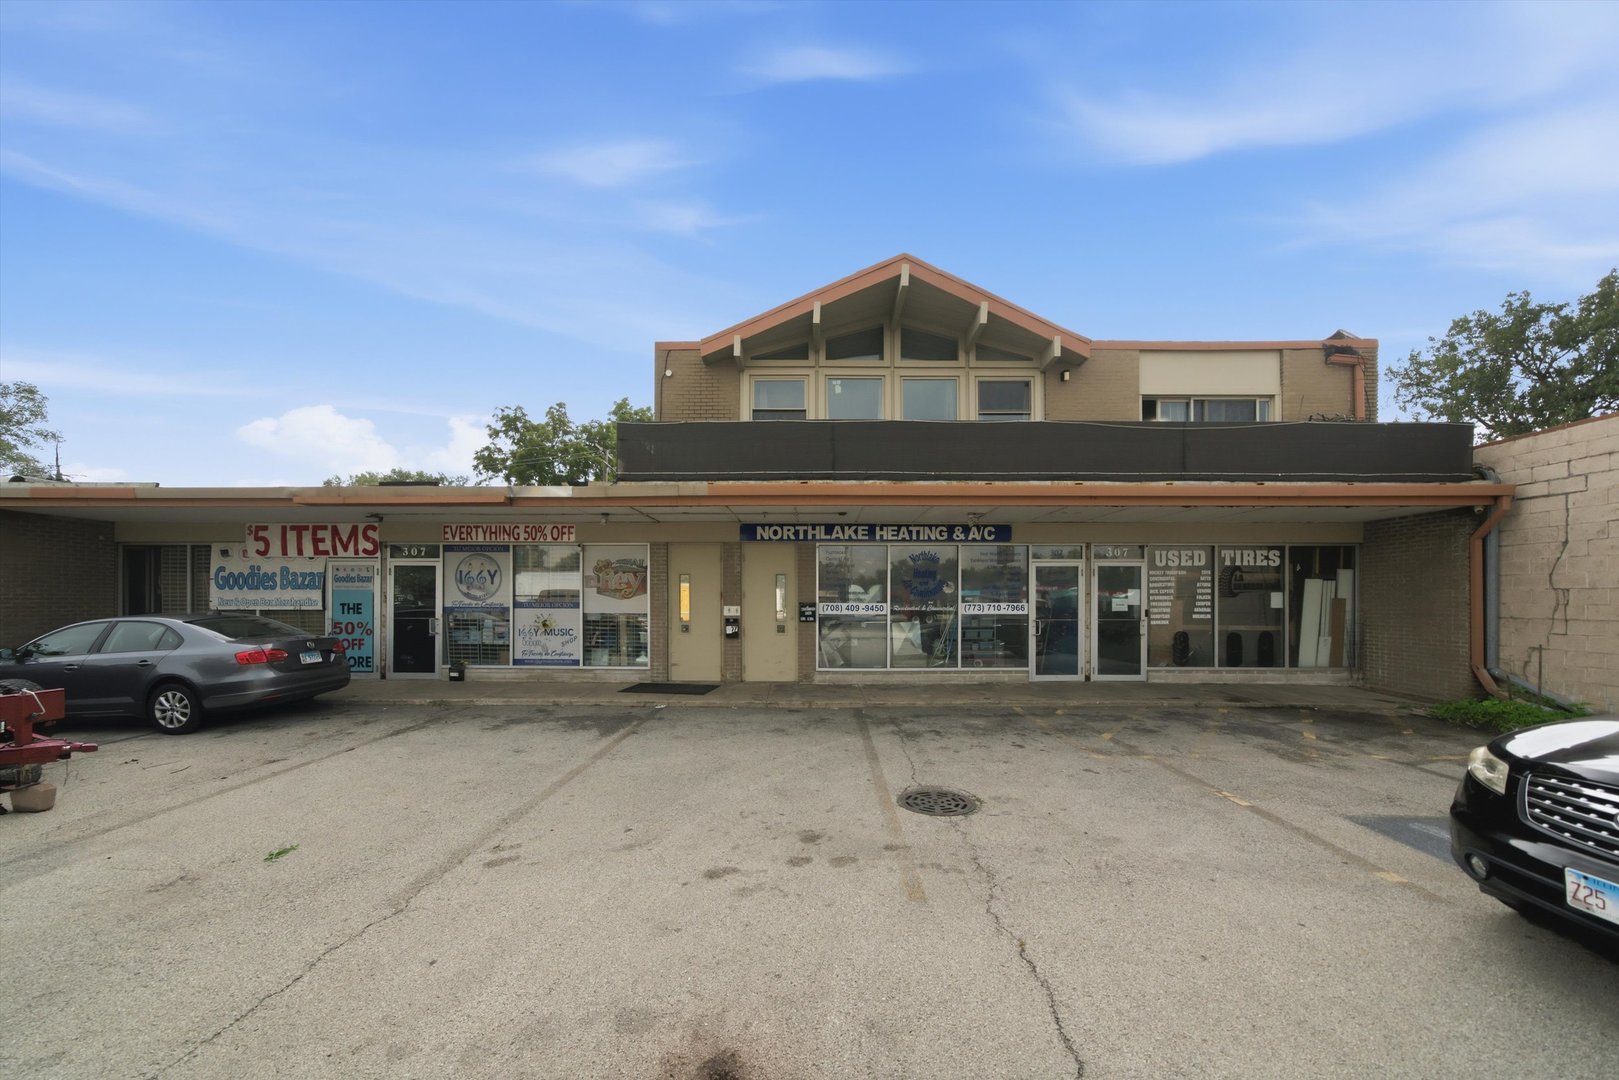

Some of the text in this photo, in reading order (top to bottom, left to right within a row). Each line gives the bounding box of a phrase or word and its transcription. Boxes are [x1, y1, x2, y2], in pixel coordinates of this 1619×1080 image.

[443, 525, 574, 541] EVERTYHING 50% OFF
[756, 526, 996, 540] NORTHLAKE HEATING & A/C
[247, 525, 379, 556] $5 ITEMS
[402, 547, 425, 556] 307
[1105, 547, 1129, 557] 307
[1154, 549, 1281, 567] USED TIRES
[214, 565, 323, 591] Goodies Bazar
[334, 573, 373, 584] Goodies Bazar
[340, 602, 362, 615] THE
[822, 603, 843, 613] (708)
[845, 604, 860, 612] 409
[861, 604, 884, 612] -9450
[964, 603, 1026, 613] (773) 710 -7966
[334, 621, 373, 636] 50%
[544, 628, 574, 637] MUSIC
[561, 635, 578, 648] SHOP
[345, 656, 372, 668] ORE
[1570, 880, 1606, 910] Z25
